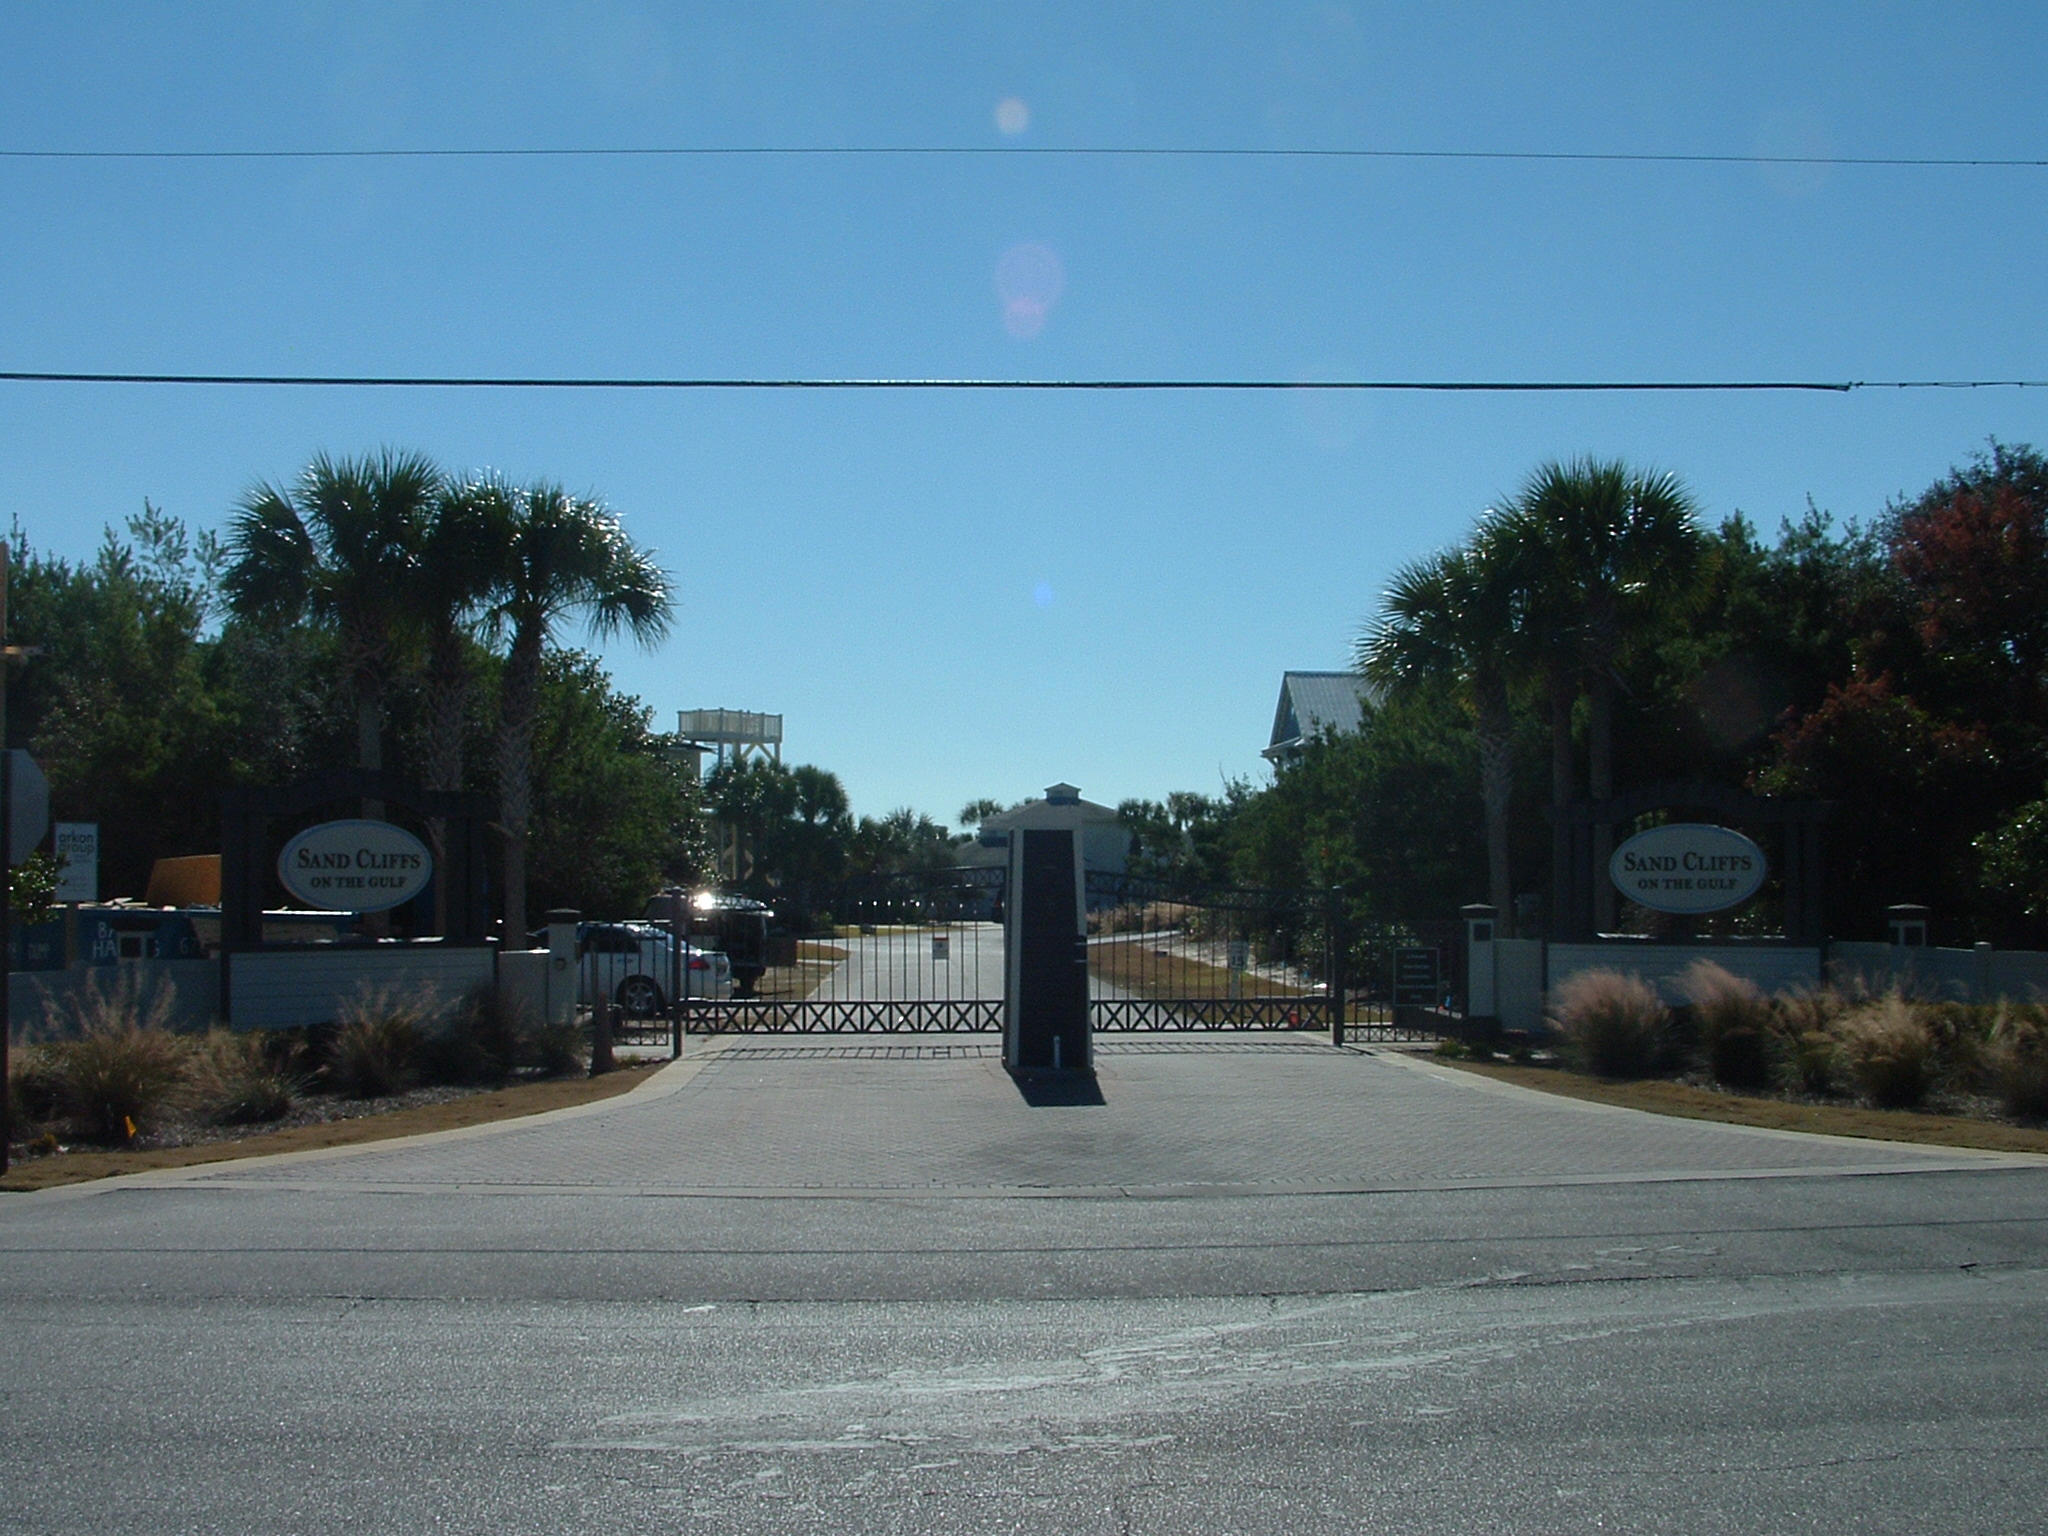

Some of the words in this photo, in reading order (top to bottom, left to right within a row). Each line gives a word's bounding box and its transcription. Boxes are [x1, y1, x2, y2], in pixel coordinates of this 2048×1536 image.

[297, 848, 351, 869] SAND
[356, 848, 421, 869] CLIFFS
[1623, 851, 1677, 871] SAND
[1683, 851, 1753, 871] CLIFFS
[311, 877, 331, 888] ON
[334, 877, 365, 888] THE
[368, 877, 407, 888] GULF
[1637, 879, 1659, 889] ON
[1663, 879, 1693, 889] THE
[1697, 879, 1737, 889] GULF
